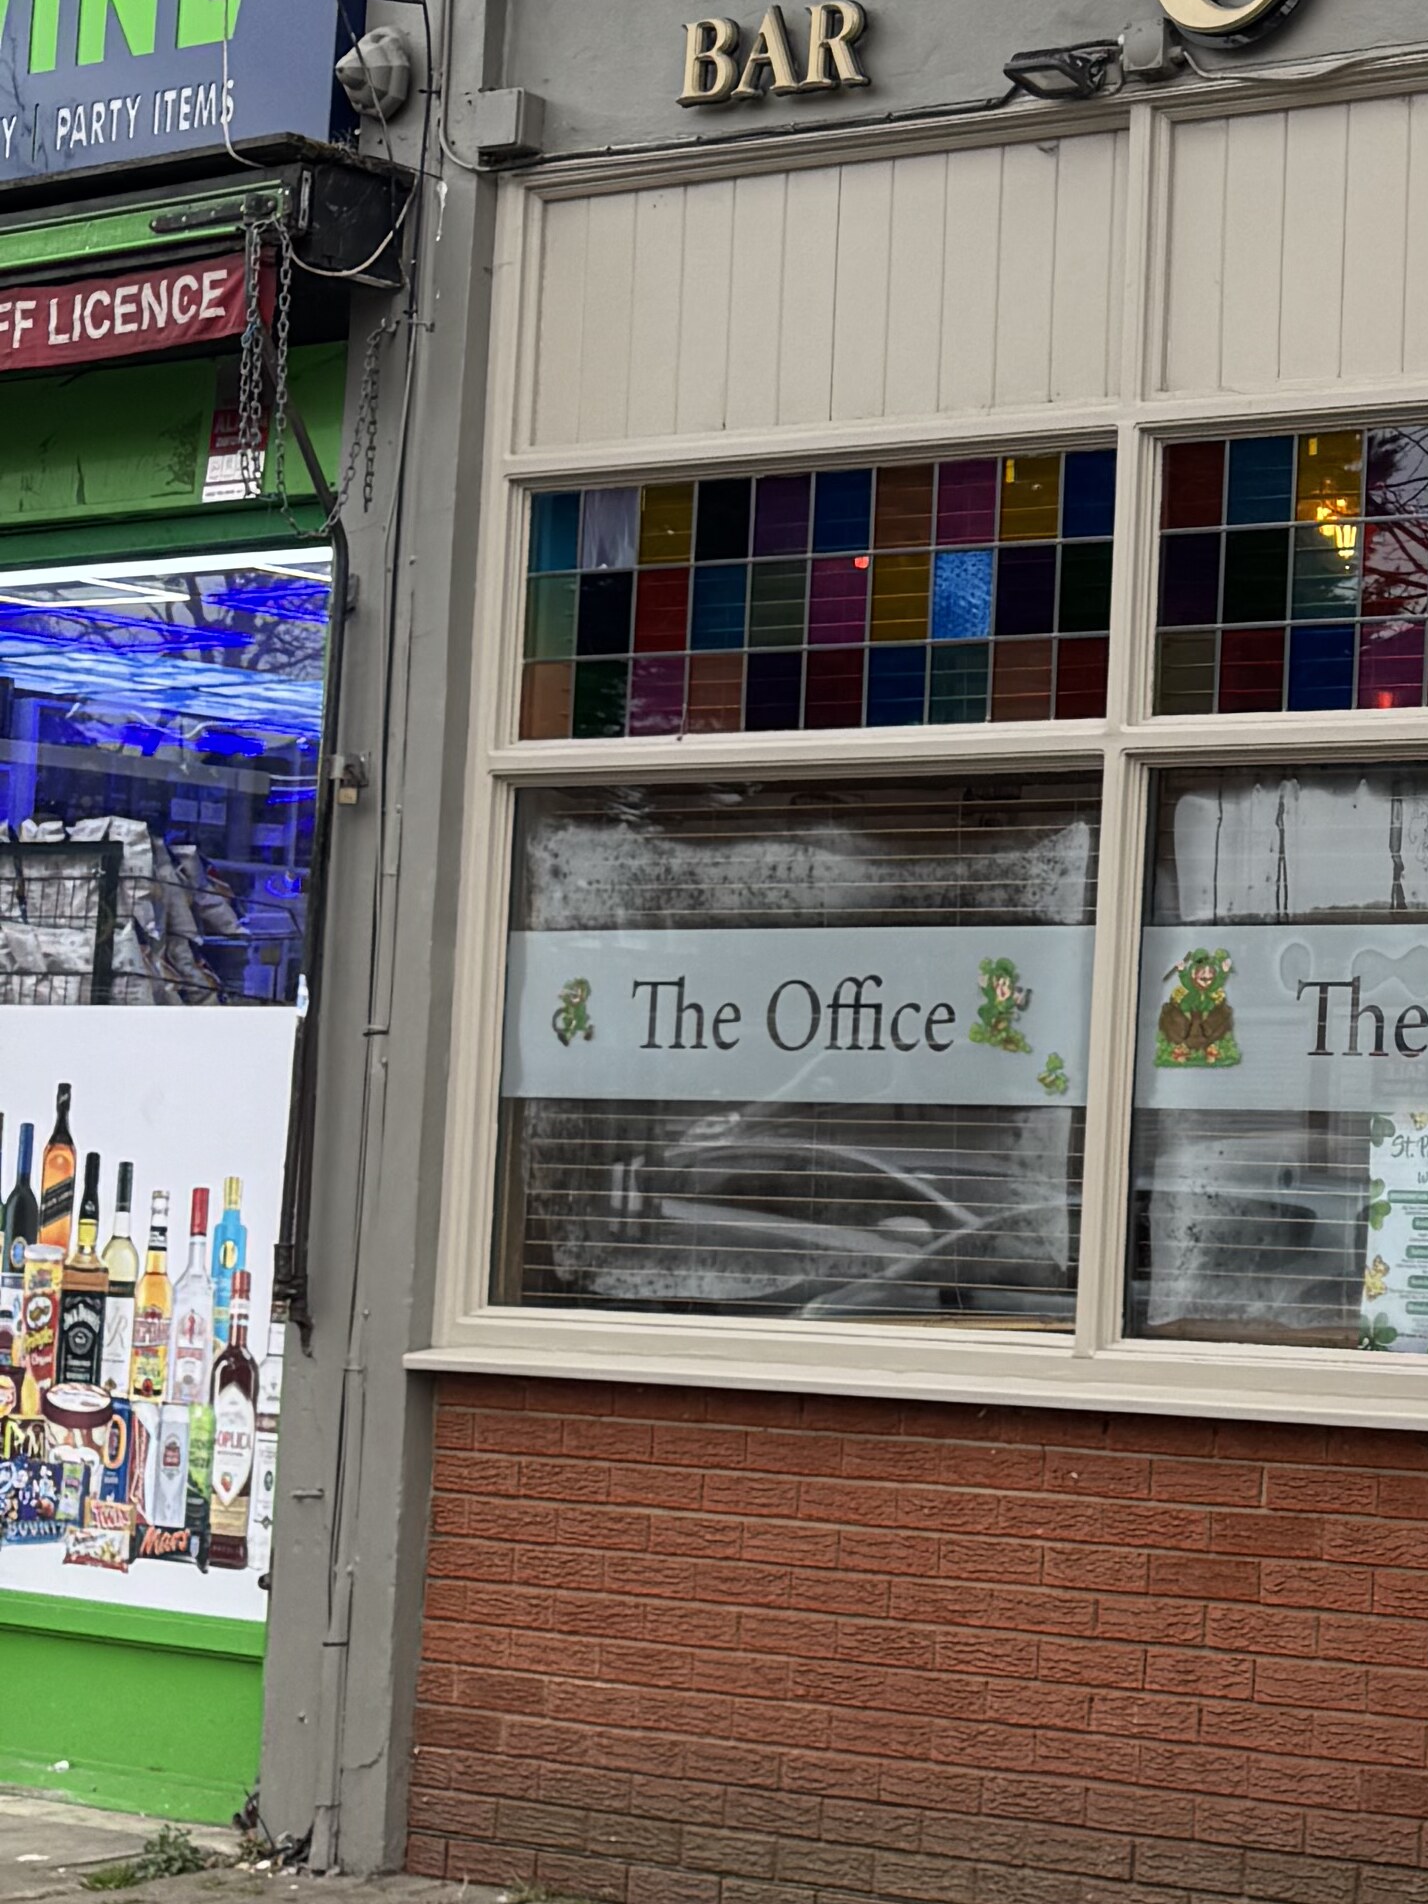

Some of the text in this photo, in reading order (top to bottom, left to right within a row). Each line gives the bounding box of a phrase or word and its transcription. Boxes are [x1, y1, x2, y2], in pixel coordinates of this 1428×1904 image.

[56, 95, 141, 151] PARTY
[154, 79, 235, 135] ITEMS
[48, 269, 228, 345] LICENCE
[632, 974, 957, 1052] The Office
